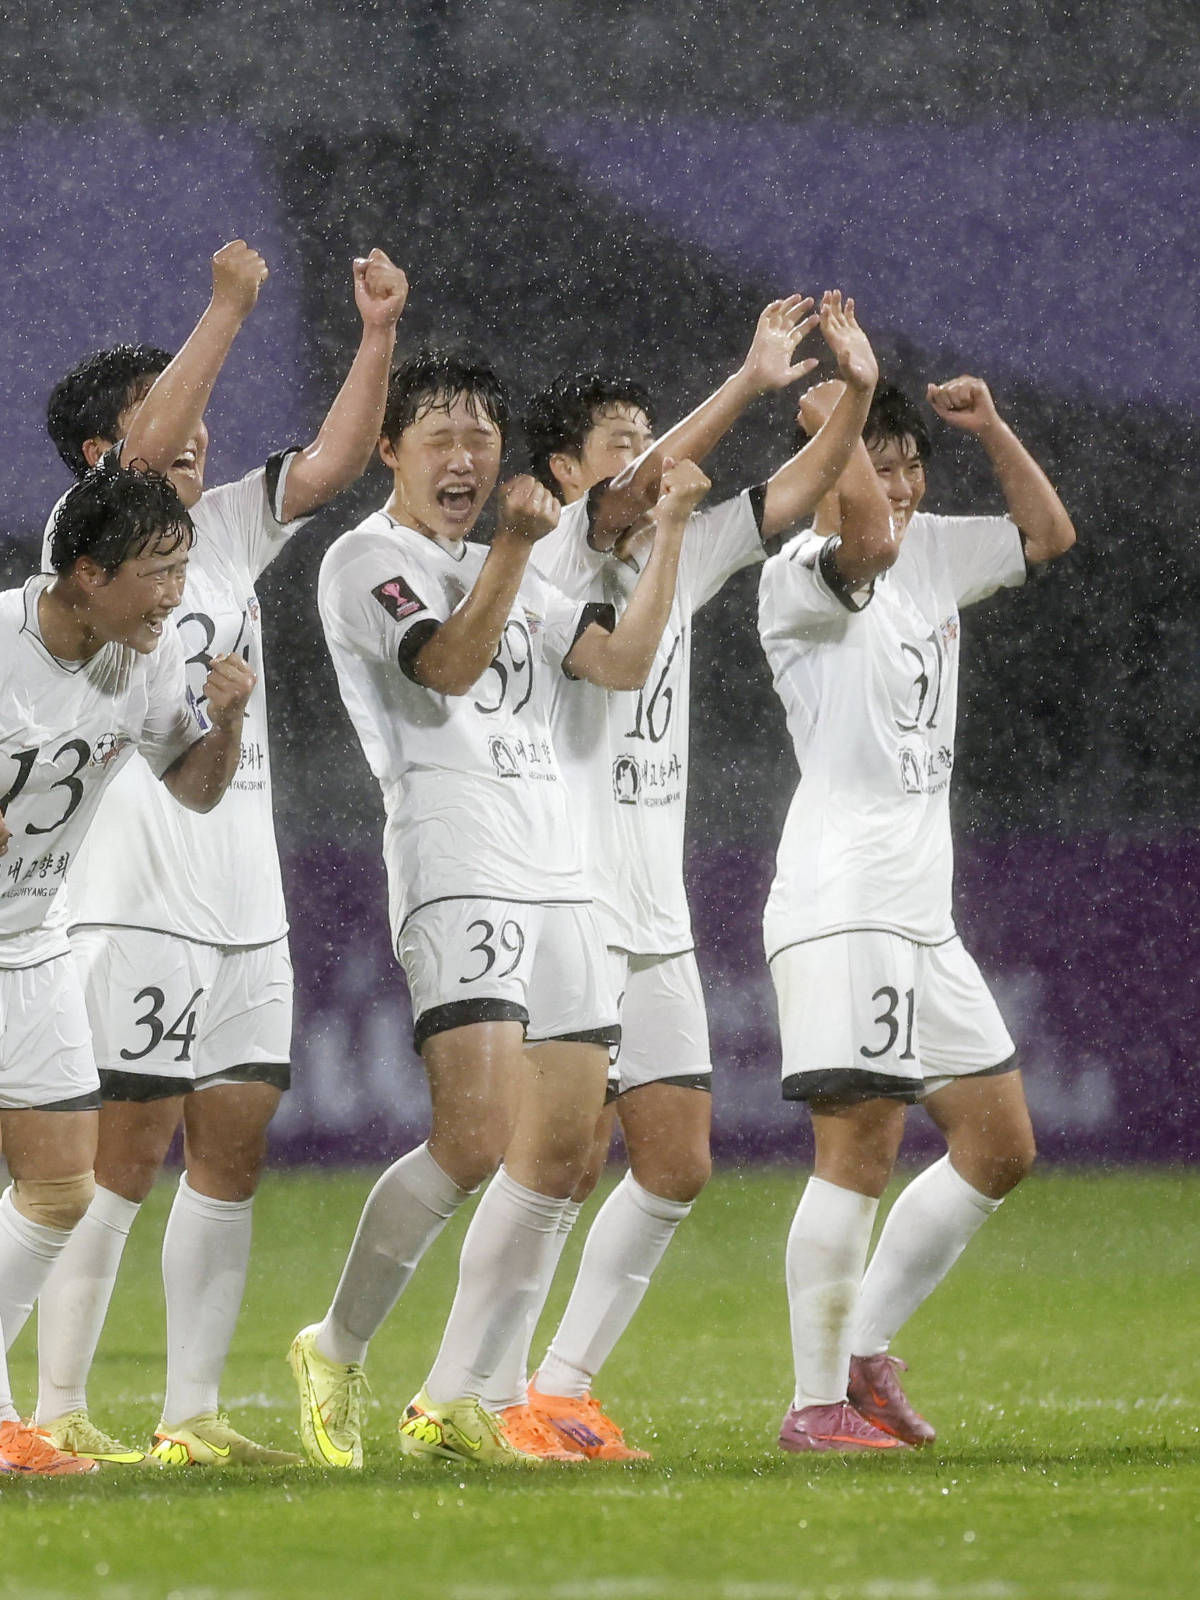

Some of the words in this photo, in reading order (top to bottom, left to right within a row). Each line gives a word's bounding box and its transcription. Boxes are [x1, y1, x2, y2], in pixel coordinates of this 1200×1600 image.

[895, 629, 943, 733] 31
[459, 919, 525, 984] 39
[119, 985, 204, 1062] 34
[859, 985, 916, 1060] 31
